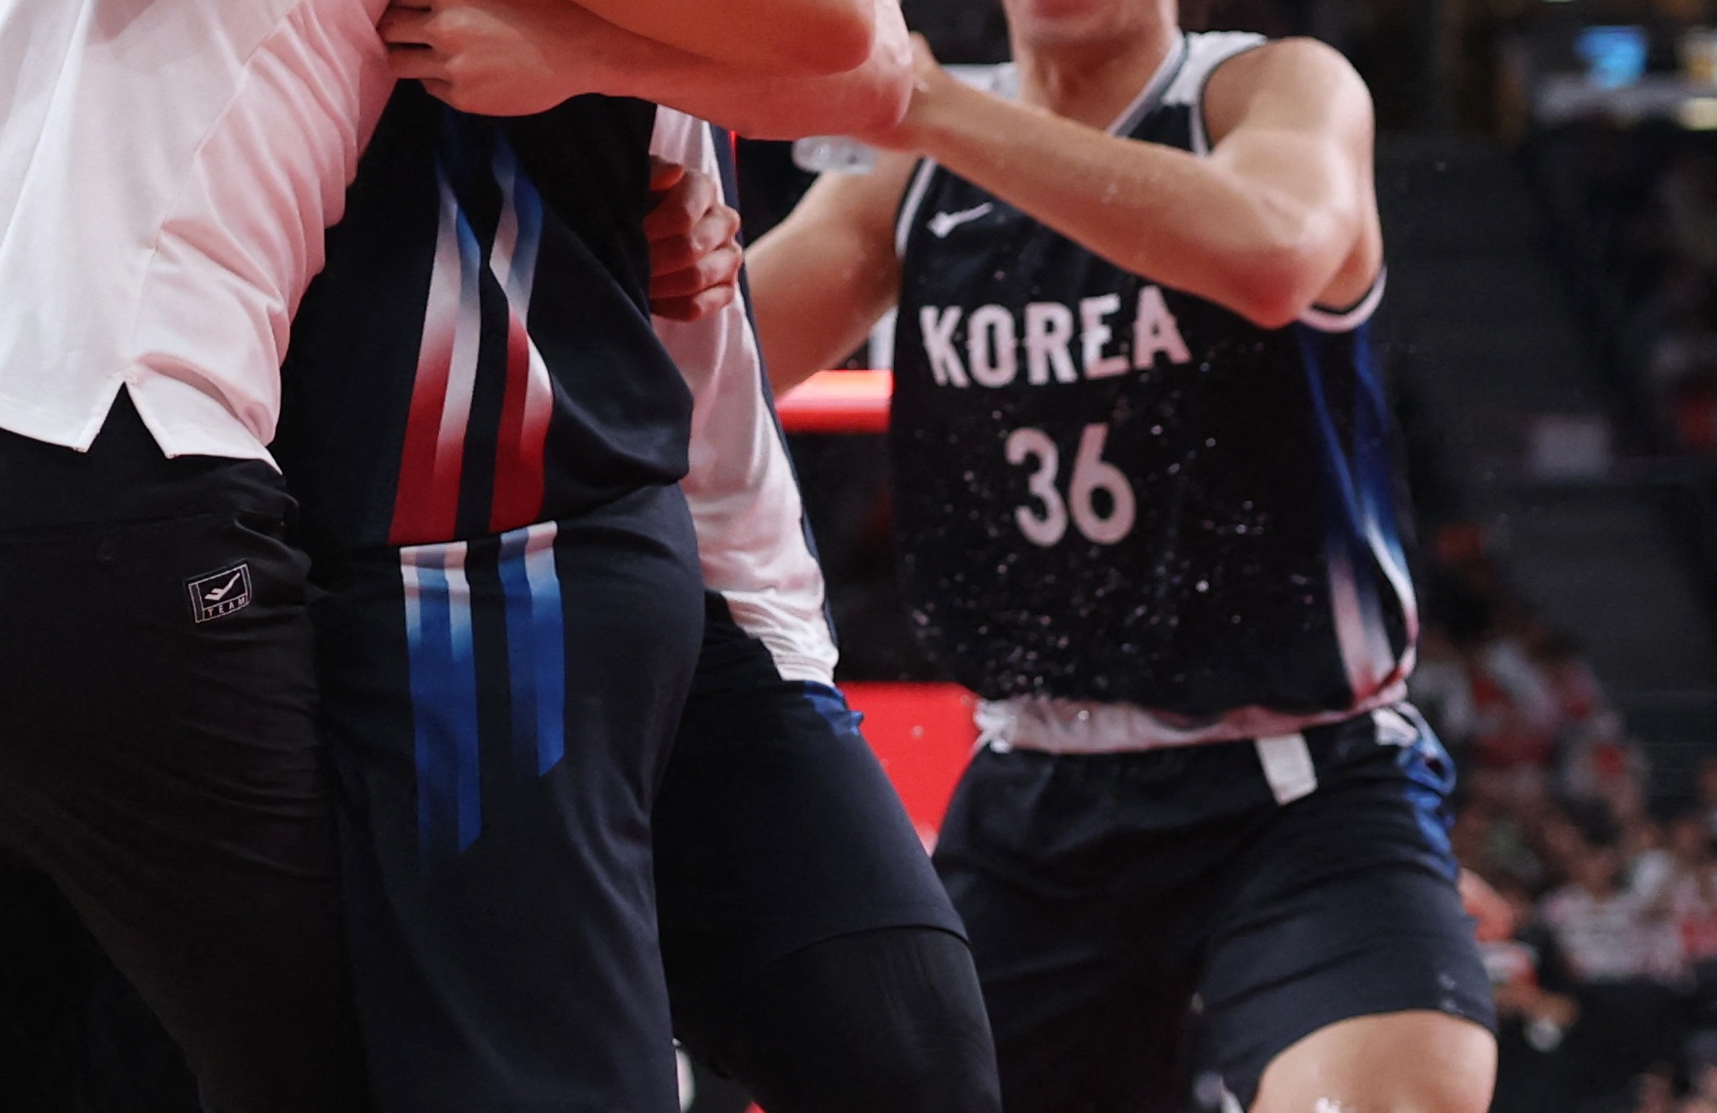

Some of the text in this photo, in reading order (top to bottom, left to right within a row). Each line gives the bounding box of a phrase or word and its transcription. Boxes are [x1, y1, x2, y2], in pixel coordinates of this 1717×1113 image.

[919, 285, 1193, 388] KOREA
[1004, 422, 1137, 548] 36
[207, 596, 246, 618] TEAM
